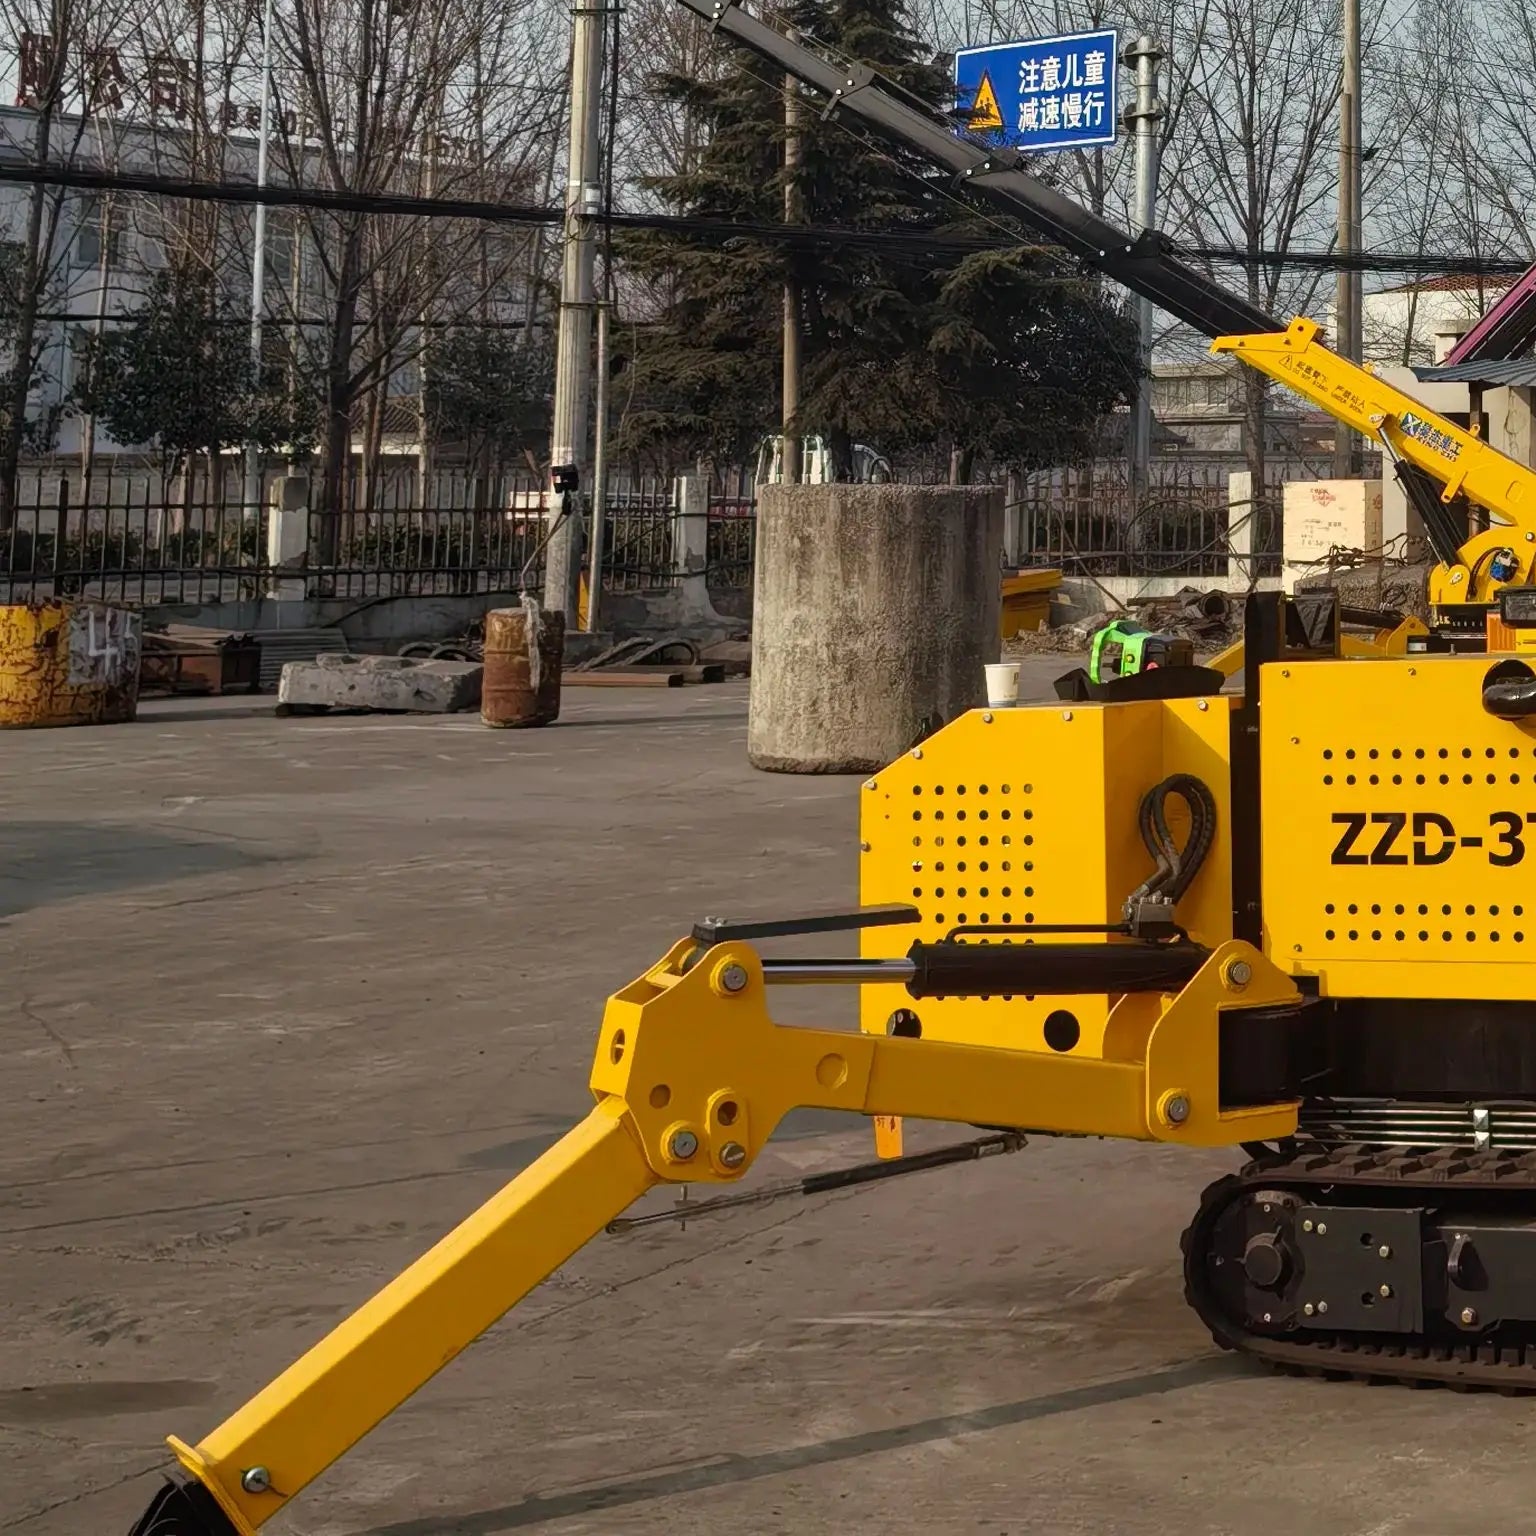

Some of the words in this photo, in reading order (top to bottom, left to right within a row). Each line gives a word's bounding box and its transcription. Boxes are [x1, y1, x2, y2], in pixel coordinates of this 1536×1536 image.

[1018, 50, 1106, 94] 注意儿童
[1018, 91, 1105, 132] 减速慢行
